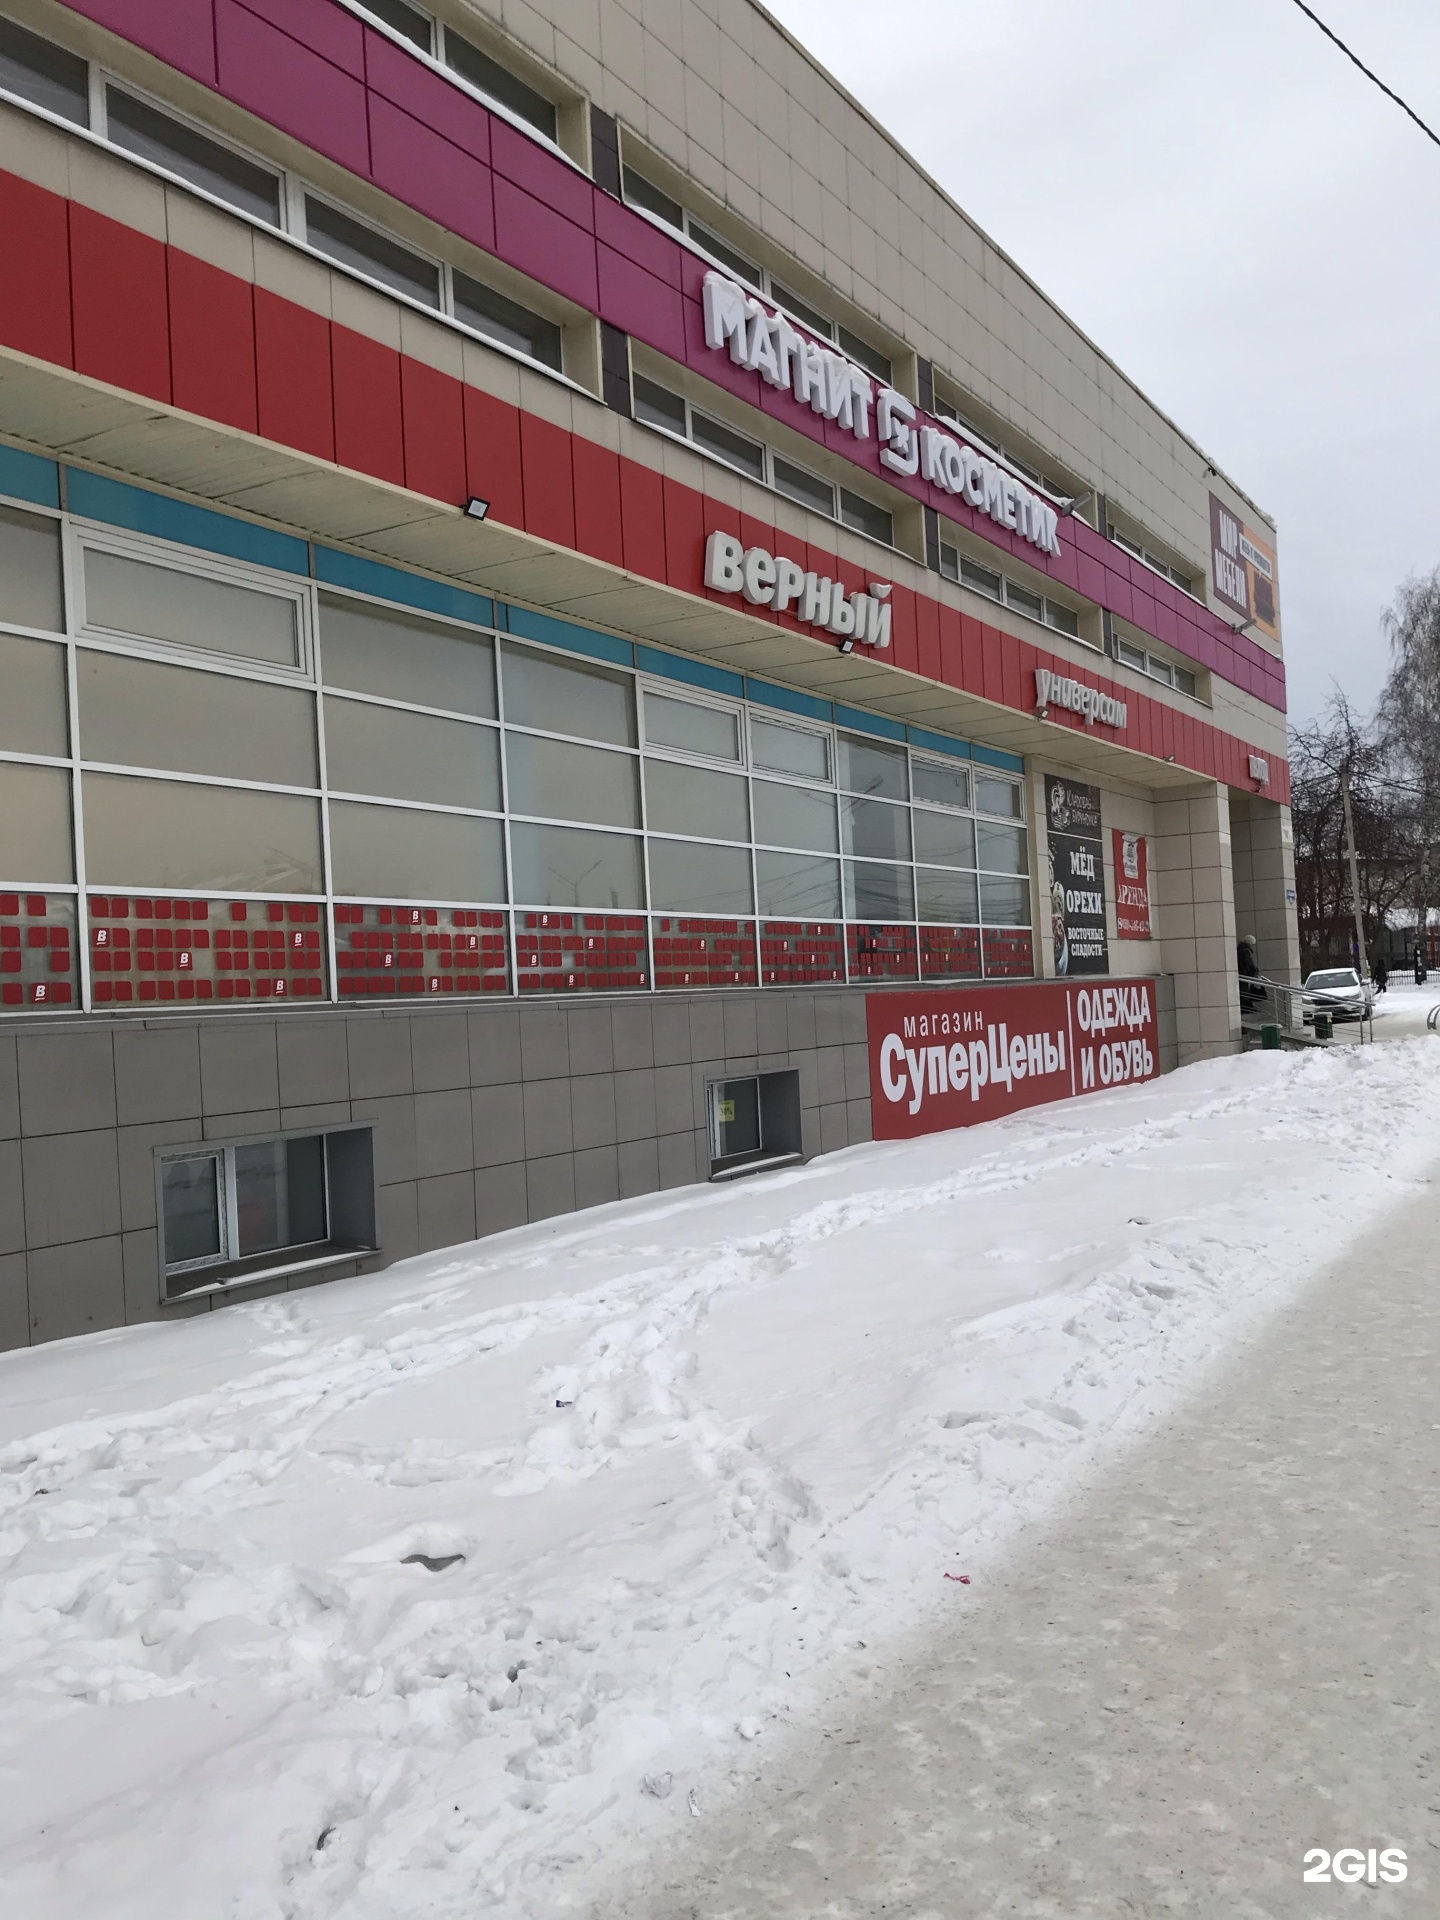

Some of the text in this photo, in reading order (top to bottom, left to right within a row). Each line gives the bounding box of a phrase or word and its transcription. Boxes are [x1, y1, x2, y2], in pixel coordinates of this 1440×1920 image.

[702, 275, 1062, 557] МАГНИТ КОСМЕТИК
[1069, 846, 1095, 881] МЁД
[1066, 890, 1103, 914] ОРЕХИ
[1067, 927, 1104, 941] ВОСТОЧНЫЕ
[1071, 943, 1103, 958] СЛАДОСТИ
[903, 1010, 984, 1038] магазин
[1077, 986, 1152, 1038] ОДЕЖДА
[880, 1022, 1066, 1116] СуперЦены
[1080, 1038, 1154, 1090] И ОБУВЬ
